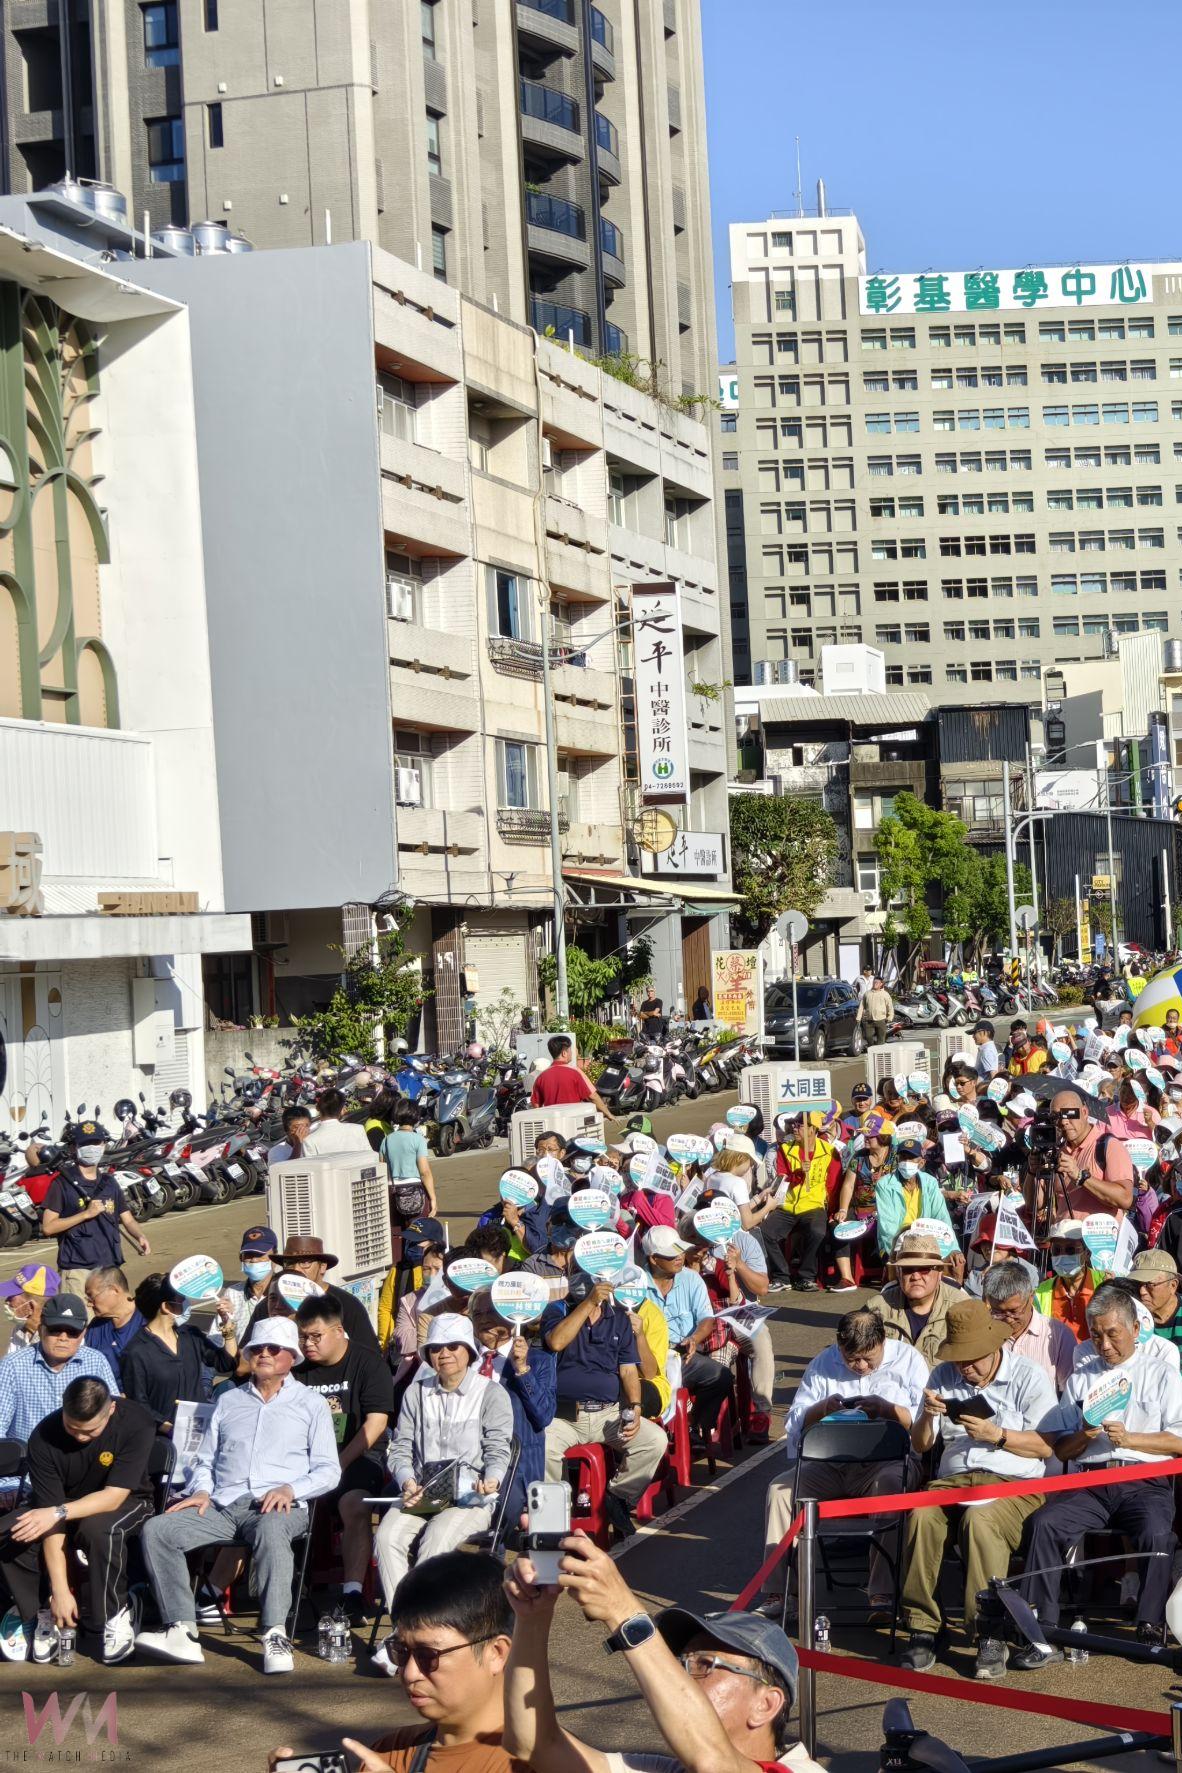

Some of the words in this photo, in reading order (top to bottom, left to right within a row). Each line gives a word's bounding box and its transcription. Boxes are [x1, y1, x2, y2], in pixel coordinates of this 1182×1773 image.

[865, 265, 1147, 313] 彰基醫學中心
[781, 1077, 827, 1098] 大同里
